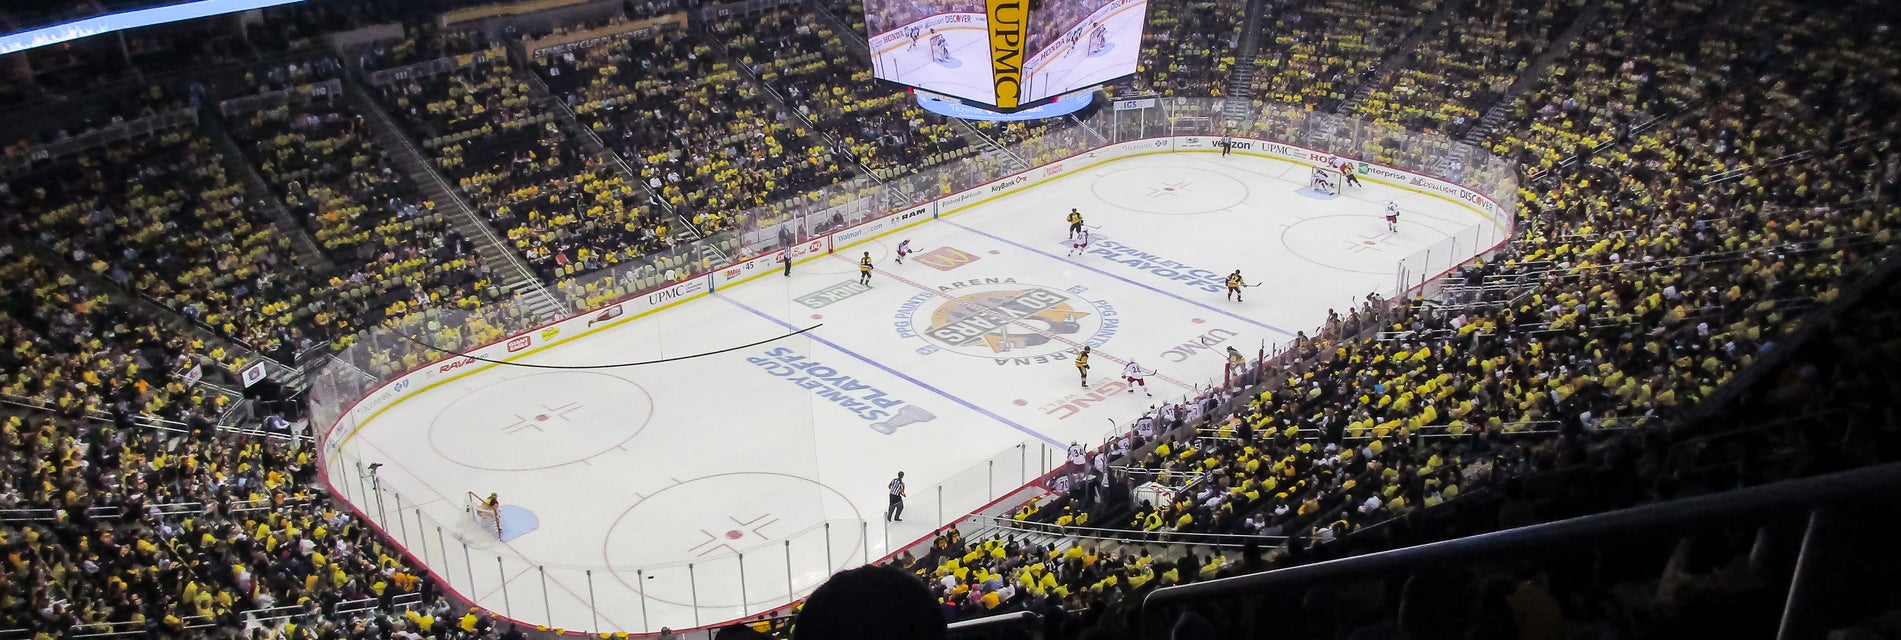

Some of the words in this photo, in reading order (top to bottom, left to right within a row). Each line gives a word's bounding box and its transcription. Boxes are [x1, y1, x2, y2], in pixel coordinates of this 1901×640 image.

[945, 15, 971, 24] DISCOVER
[883, 31, 904, 44] HONDA
[994, 1, 1020, 99] UPMC
[1123, 101, 1137, 109] IGS
[1212, 140, 1251, 151] vezon
[1262, 142, 1292, 156] UPMC
[991, 180, 1016, 193] KeyBank
[1460, 189, 1493, 212] DISCOVER
[902, 208, 926, 220] RAM
[838, 229, 862, 242] Walmart
[1096, 240, 1193, 270] STANLEY
[1087, 248, 1227, 293] PLAYOFFS
[938, 277, 1018, 292] ARENA
[649, 286, 685, 306] UPMC
[1018, 290, 1063, 309] 50
[933, 303, 1026, 343] YEARS
[1160, 328, 1239, 363] UPMC
[439, 357, 476, 374] RAV4
[746, 356, 795, 380] CUP
[1131, 365, 1141, 374] 22
[764, 347, 905, 409] PLAYOFFS
[787, 376, 890, 422] STANLEY
[1046, 381, 1128, 421] GNC
[1073, 447, 1084, 458] 34
